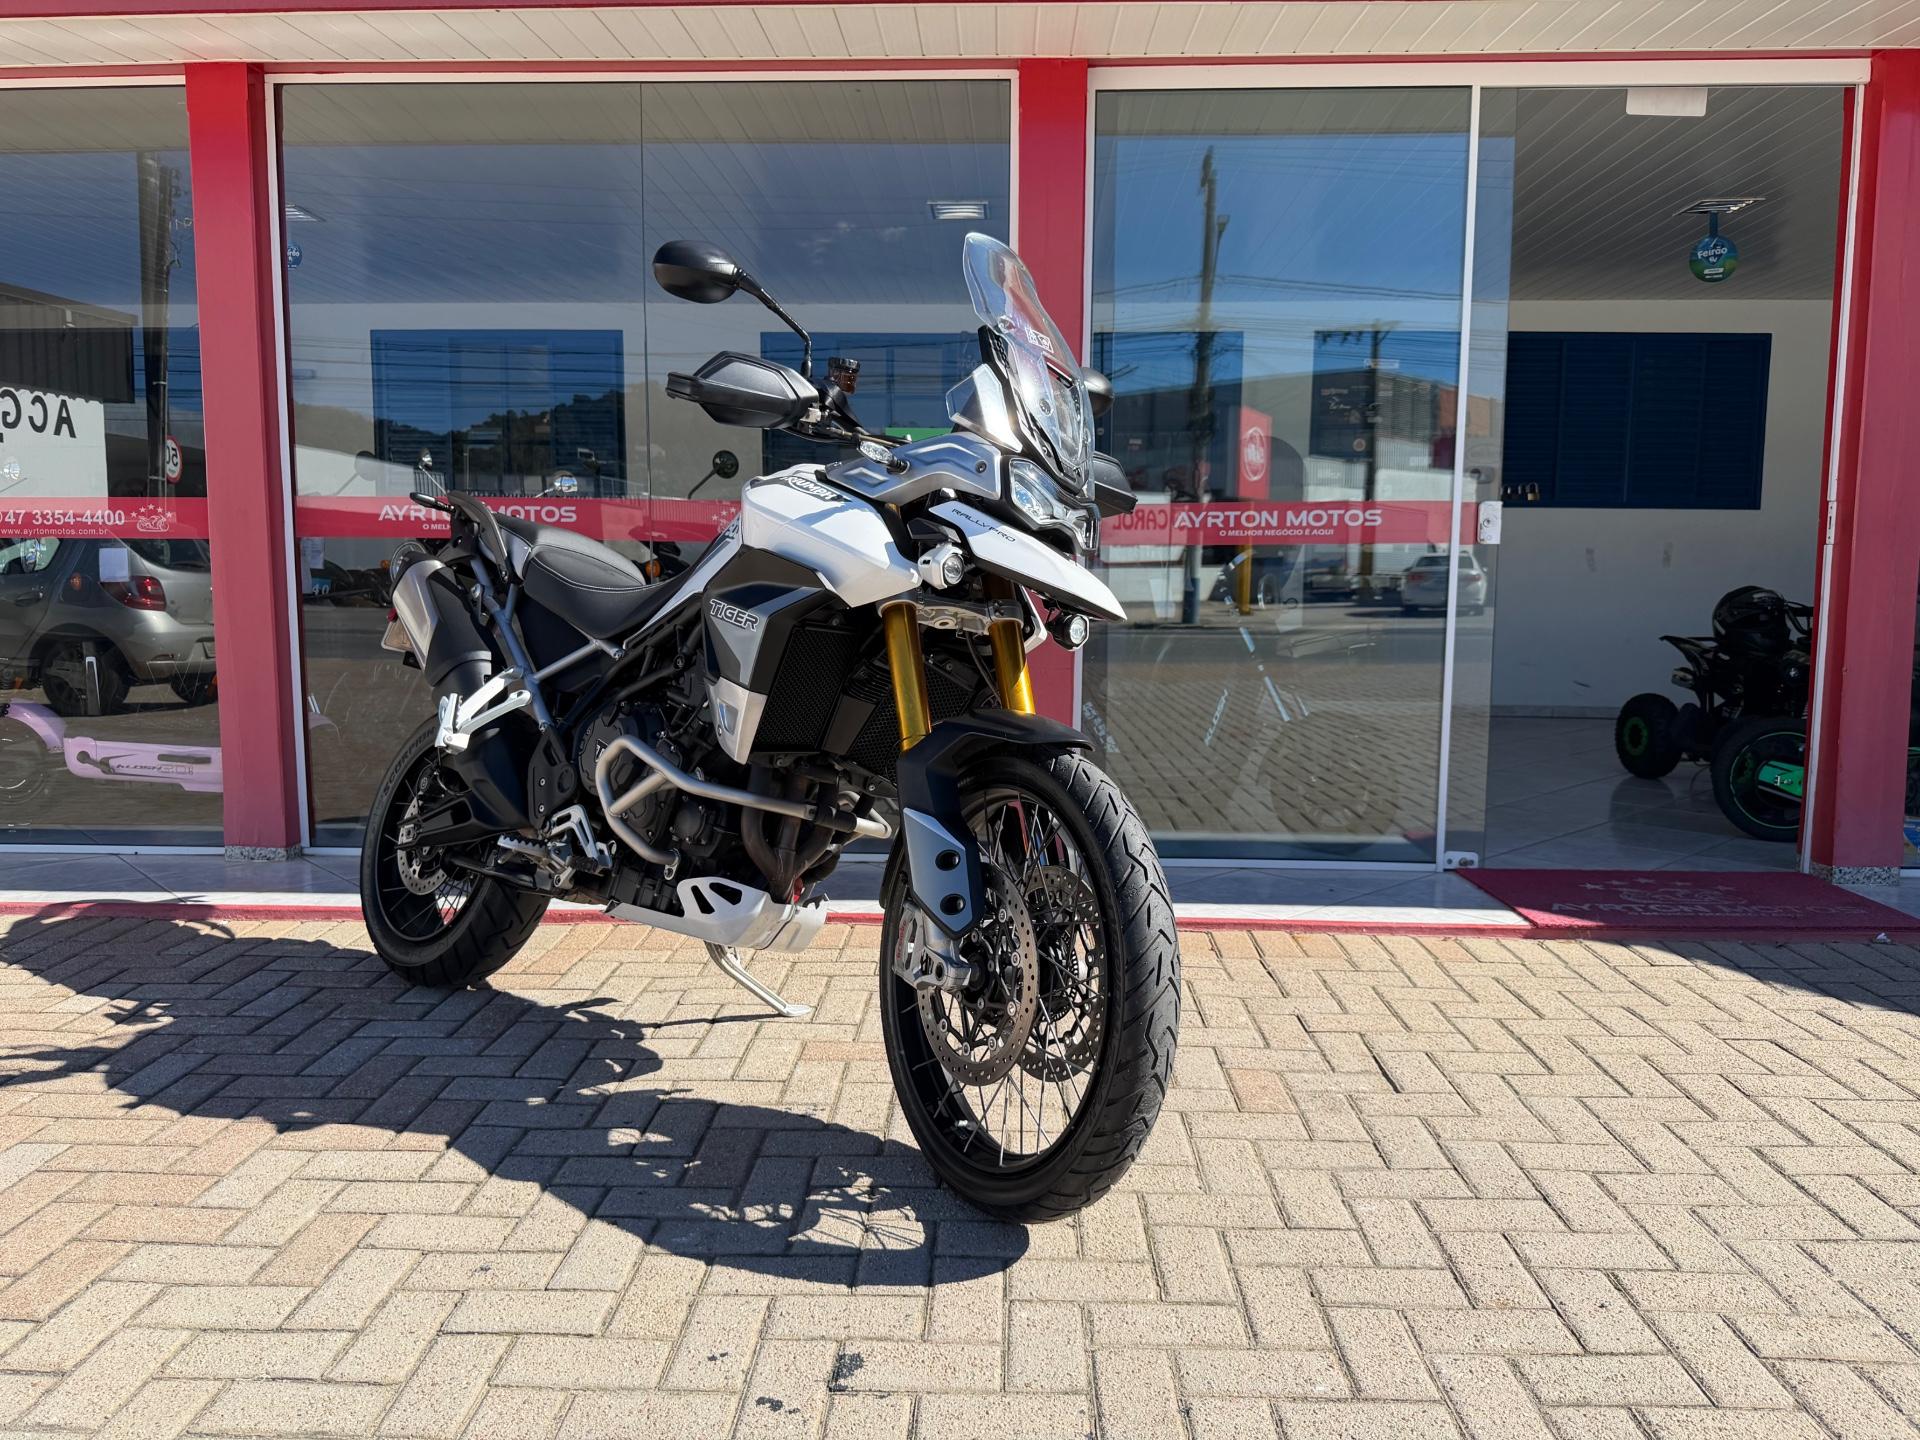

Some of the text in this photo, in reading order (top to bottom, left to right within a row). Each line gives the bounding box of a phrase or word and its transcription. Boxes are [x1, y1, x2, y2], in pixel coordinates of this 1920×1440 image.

[1697, 246, 1728, 260] Feirão
[32, 509, 125, 526] 3354-4400
[1174, 509, 1383, 528] AYRTON MOTOS
[1, 528, 109, 536] www.ayrtonmotos.com.br
[1228, 529, 1263, 537] MELHOR
[1264, 527, 1302, 536] NEGÓCIO
[1311, 527, 1334, 536] AQUI
[709, 598, 760, 633] TIGER
